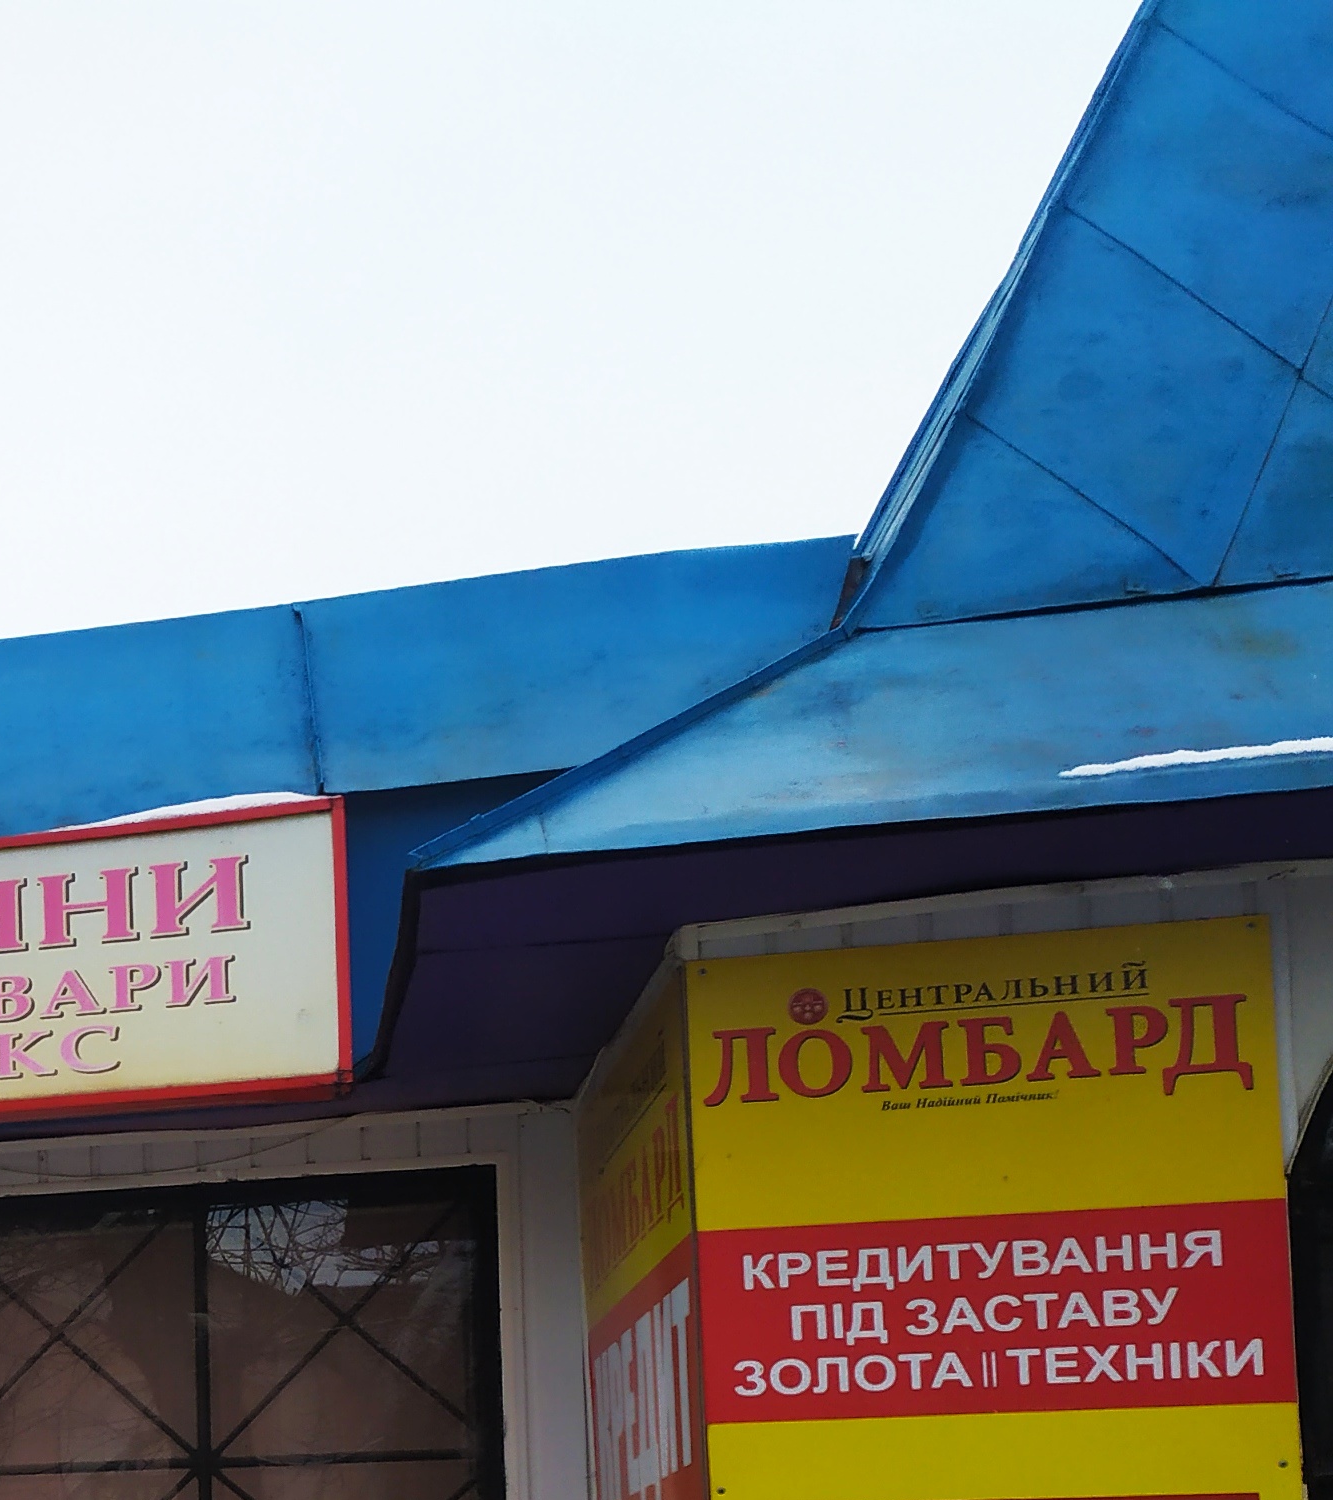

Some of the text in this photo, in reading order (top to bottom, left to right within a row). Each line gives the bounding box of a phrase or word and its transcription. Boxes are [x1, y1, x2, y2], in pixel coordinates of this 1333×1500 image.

[837, 961, 1149, 1023] ЦЕНТРАЛЬНИЙ
[703, 994, 1255, 1107] ЛОМБАРД
[881, 1100, 911, 1111] Ваш
[742, 1229, 1224, 1292] КРЕДИТУВАННЯ
[790, 1287, 1179, 1346] ПІД ЗАСТАВУ
[734, 1352, 973, 1397] ЗОЛОТА
[1005, 1339, 1265, 1386] ТЕХНІКИ
